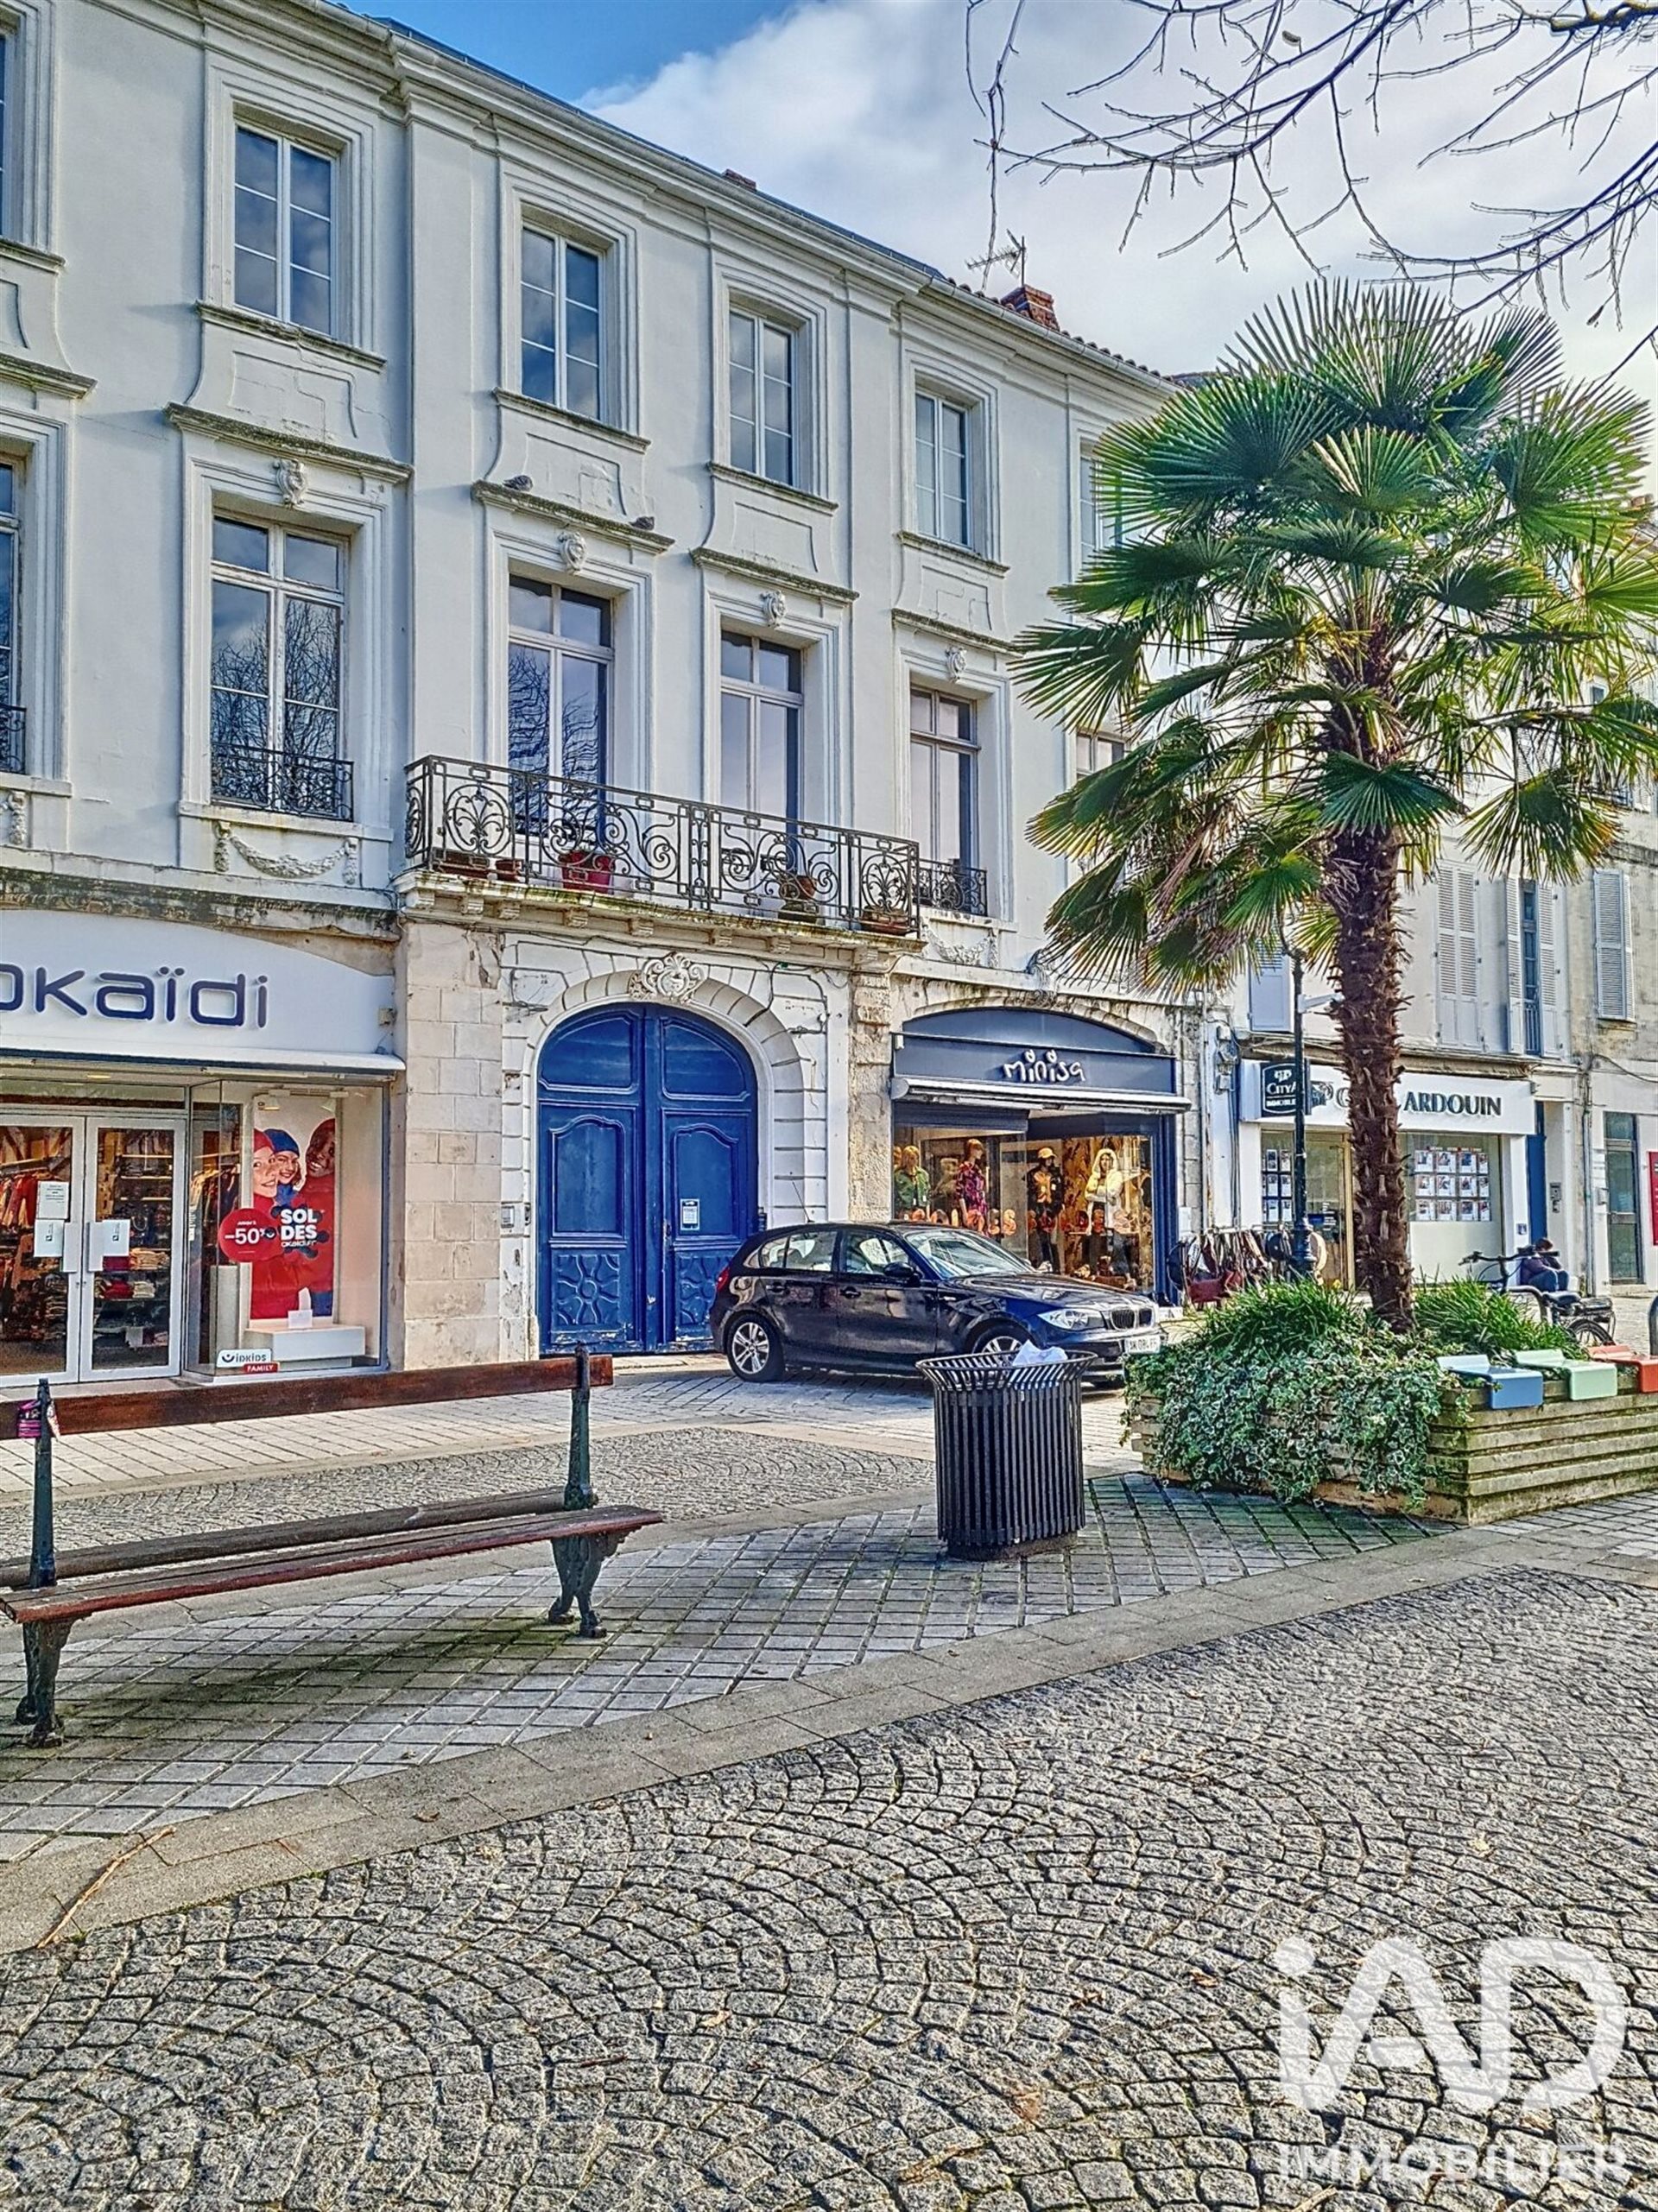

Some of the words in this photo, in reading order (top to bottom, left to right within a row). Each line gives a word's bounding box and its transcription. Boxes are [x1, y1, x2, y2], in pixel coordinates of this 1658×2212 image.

[1403, 1091, 1503, 1116] ARDOUIN
[281, 1209, 318, 1224] SOL
[281, 1224, 318, 1241] DES
